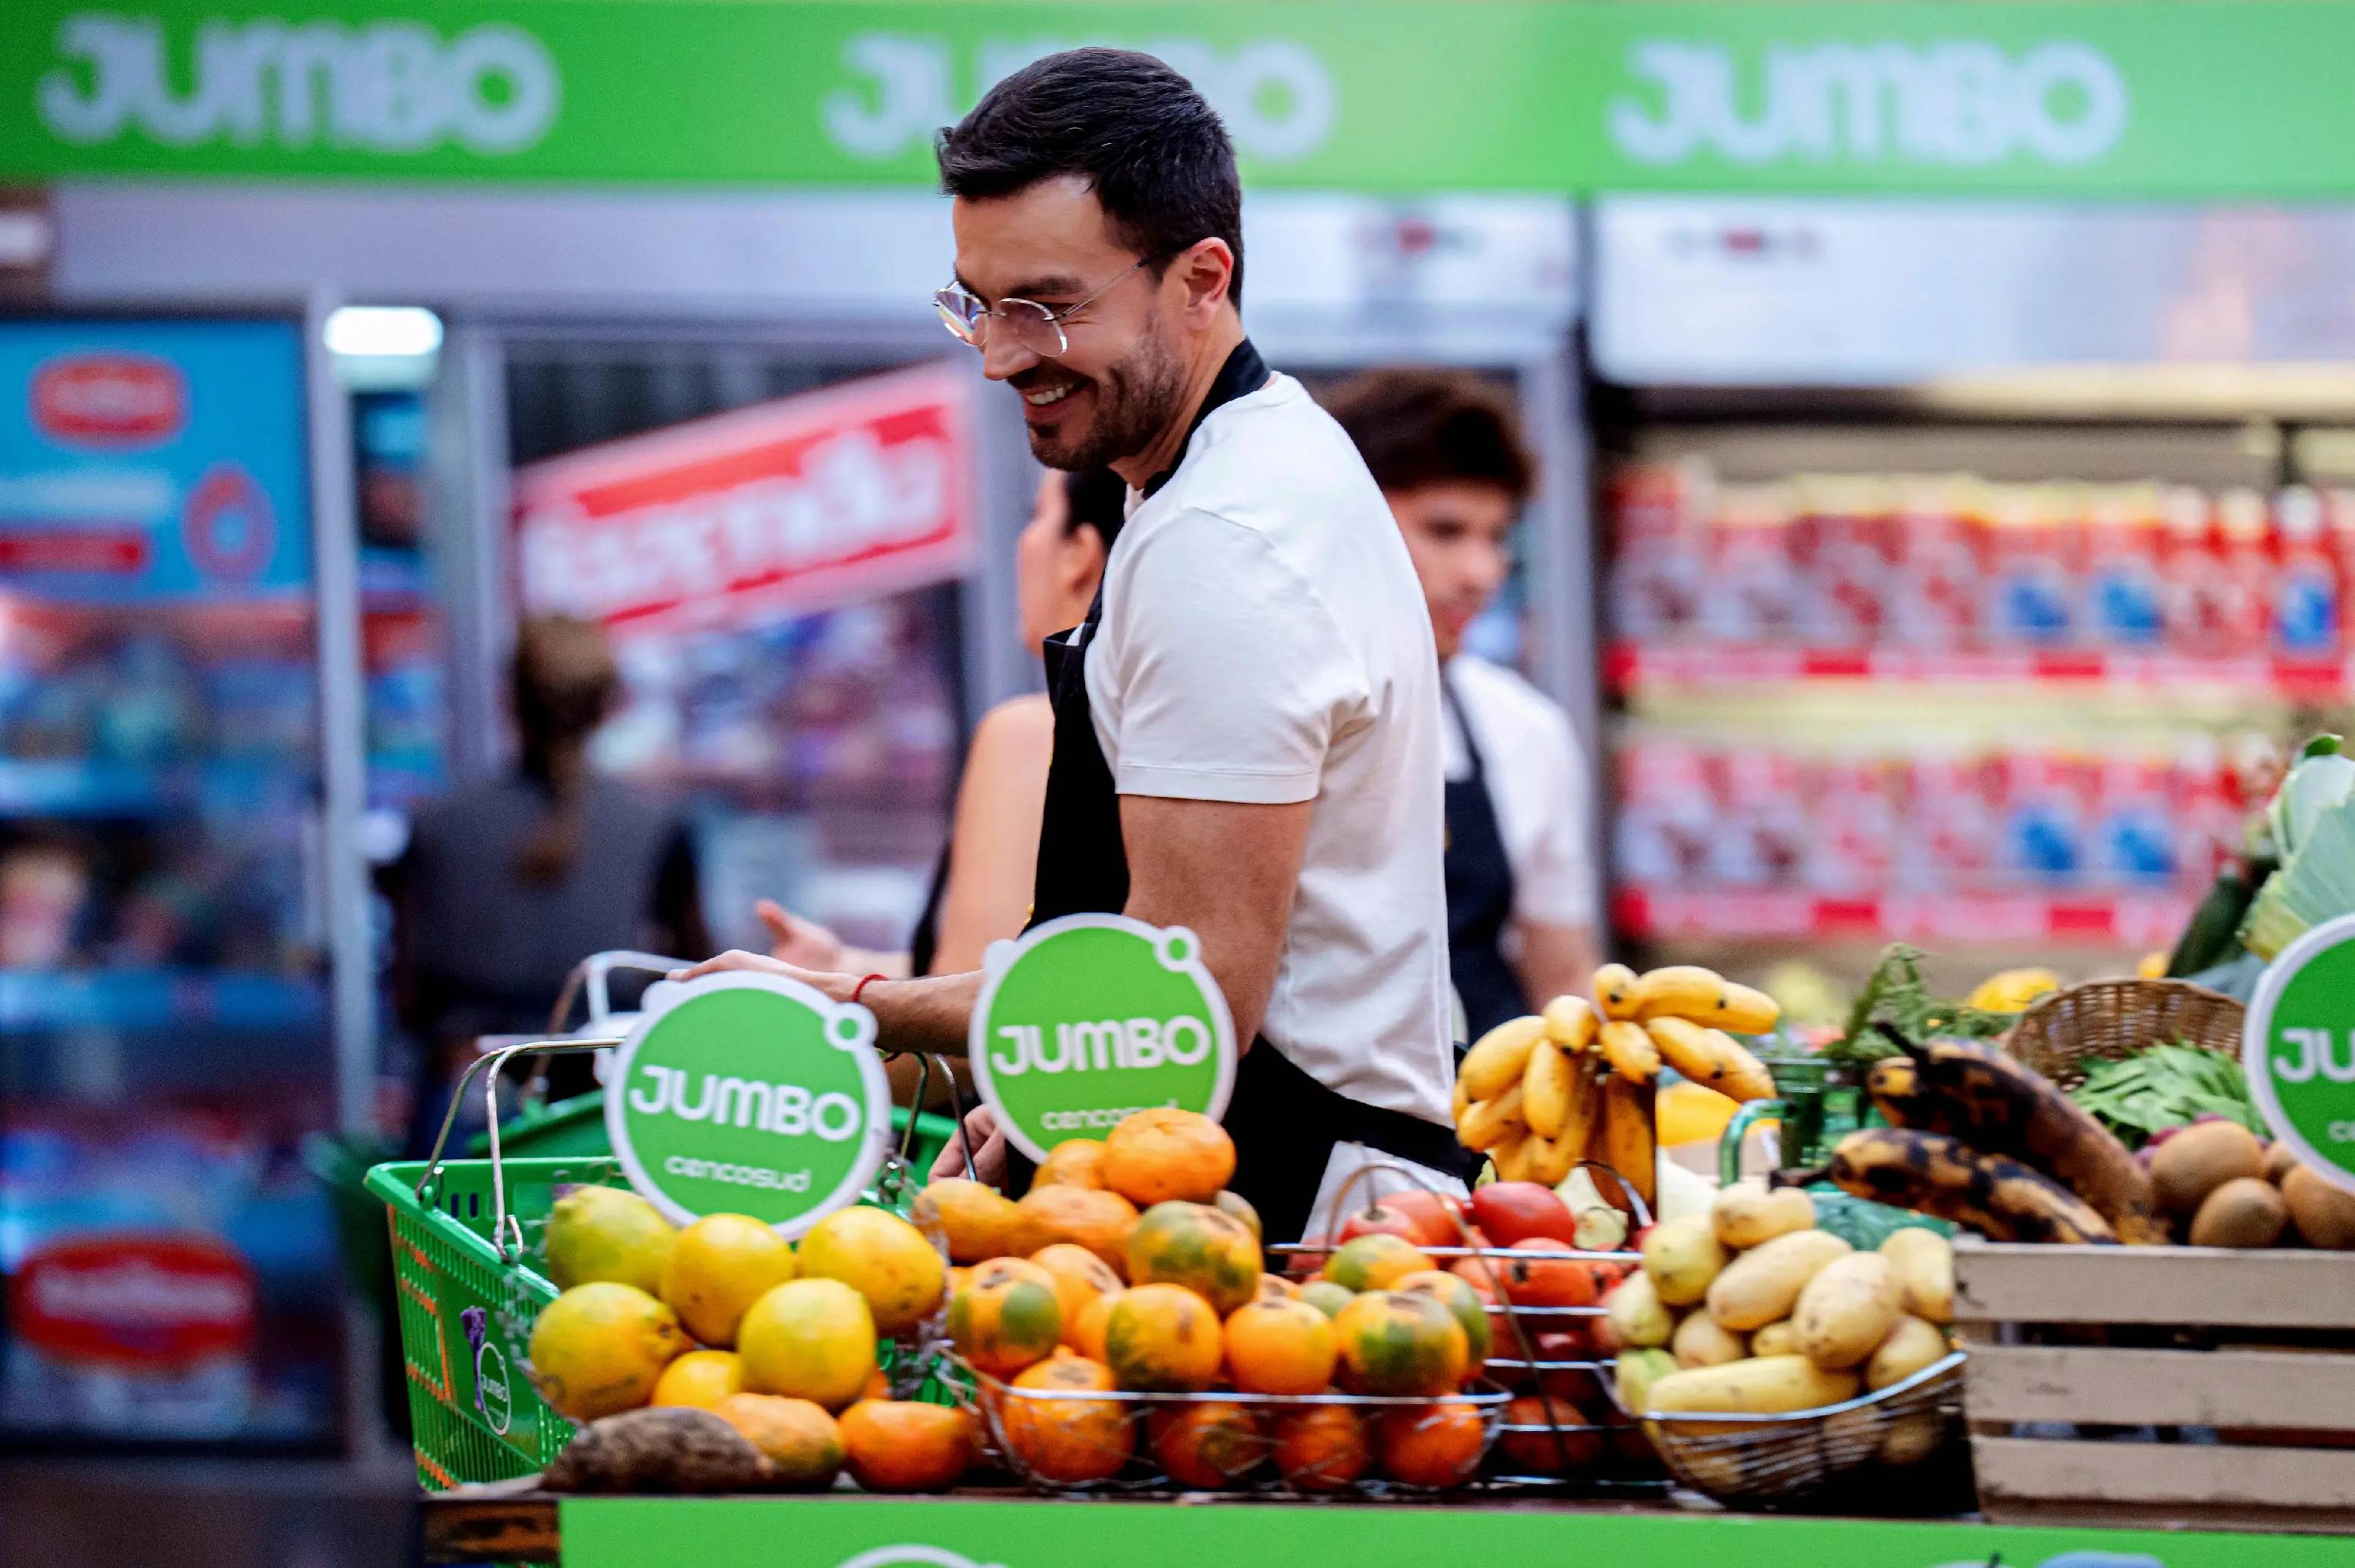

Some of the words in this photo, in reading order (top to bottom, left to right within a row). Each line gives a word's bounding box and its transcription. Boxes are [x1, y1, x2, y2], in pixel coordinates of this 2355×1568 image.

[41, 17, 562, 154] JUMBO
[1612, 38, 2127, 166] JUMBO
[991, 1015, 1210, 1075] JUMBO
[629, 1064, 860, 1142] JUMBO
[664, 1156, 812, 1193] cencosud
